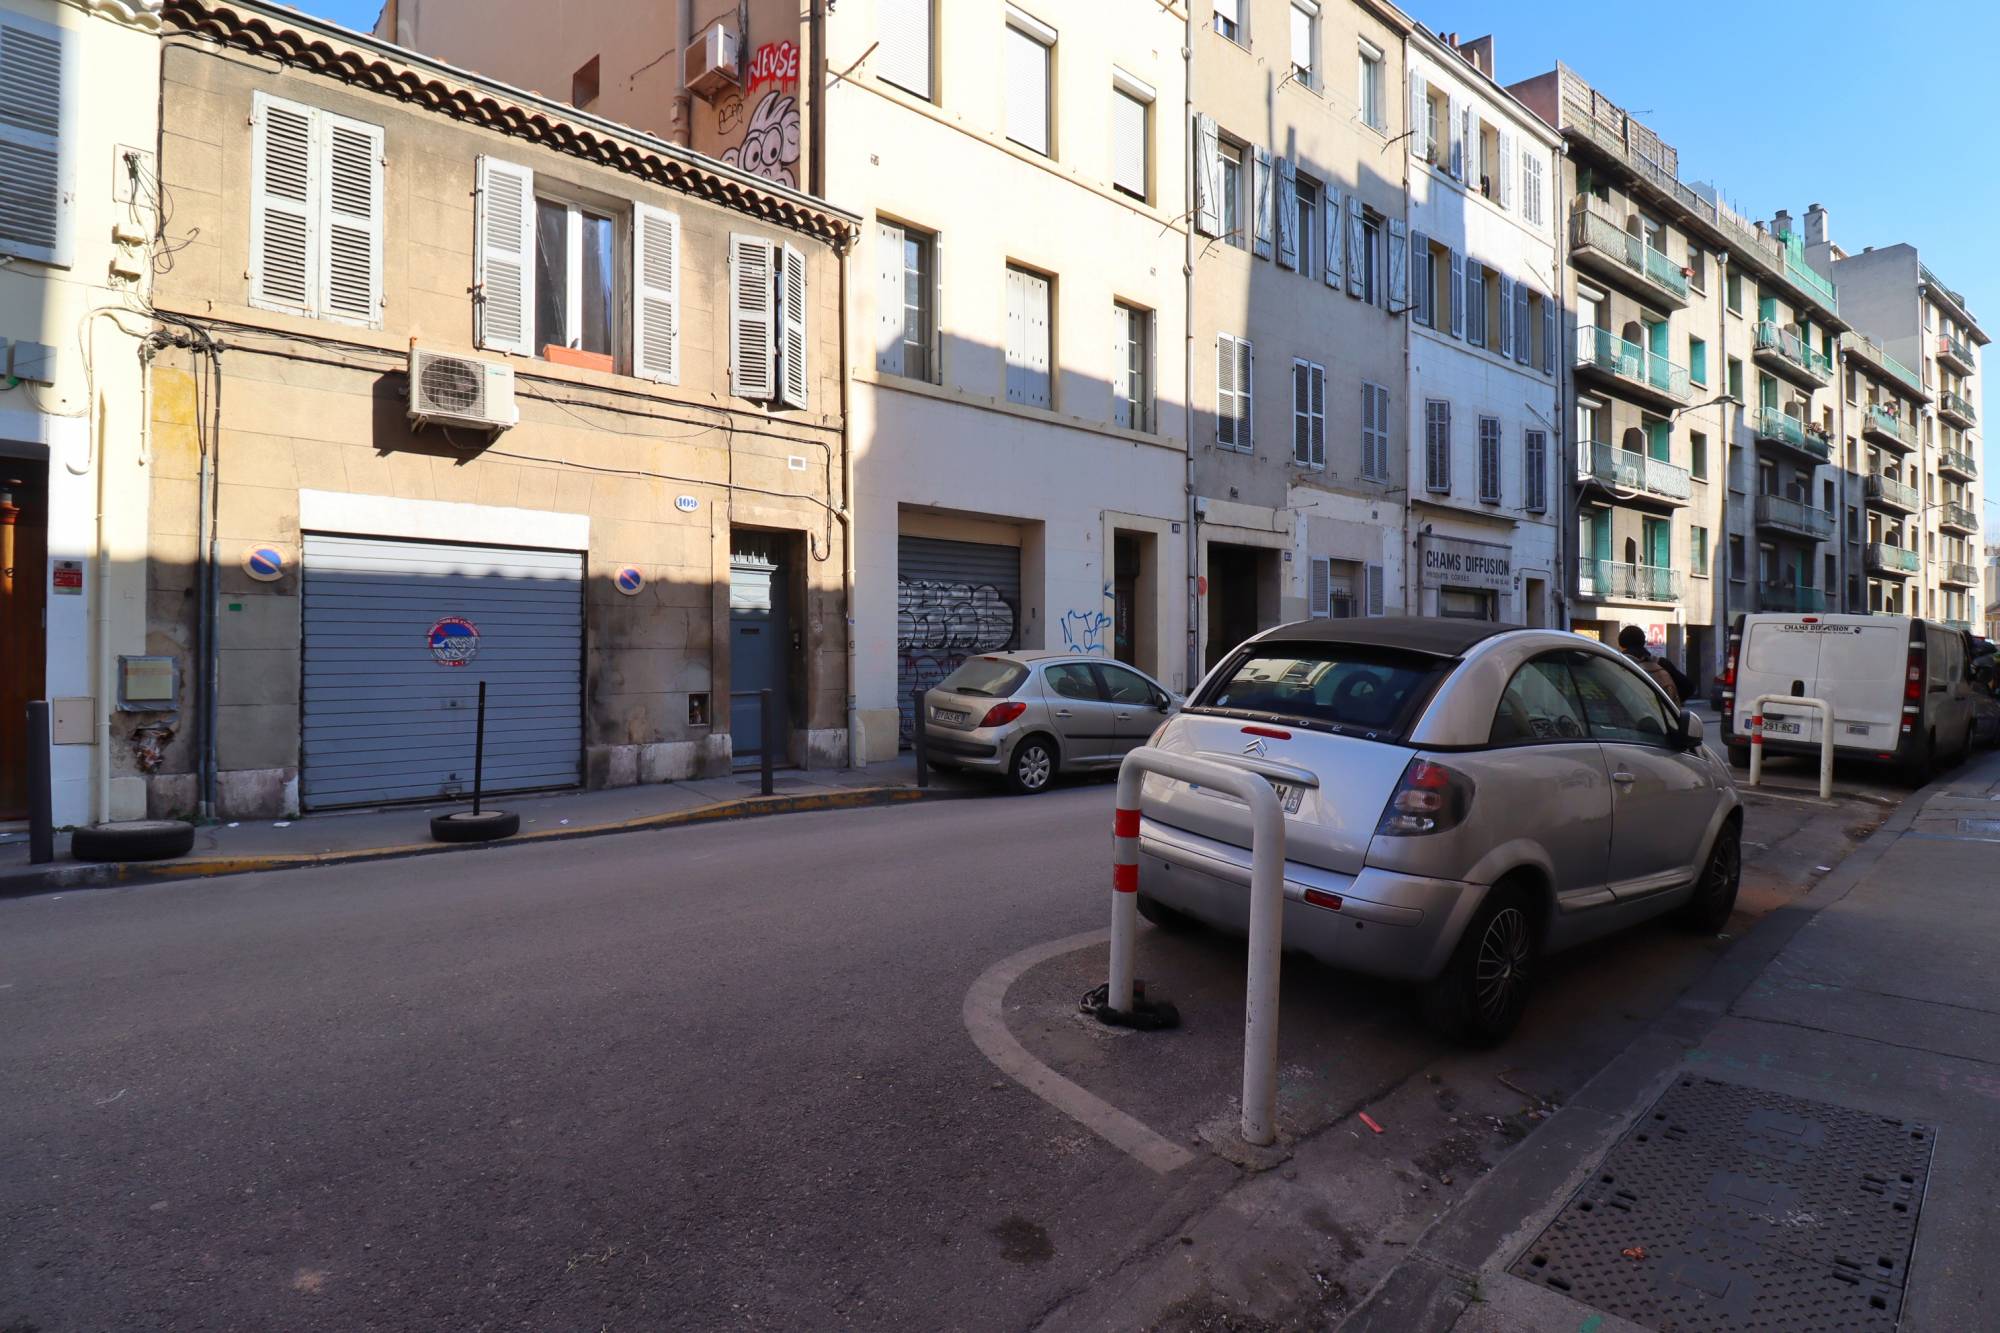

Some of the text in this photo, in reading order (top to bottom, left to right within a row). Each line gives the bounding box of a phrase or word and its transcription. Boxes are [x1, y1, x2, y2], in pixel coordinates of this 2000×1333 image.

[678, 497, 698, 508] 109
[1426, 550, 1509, 576] CHAMS DIFFUSION
